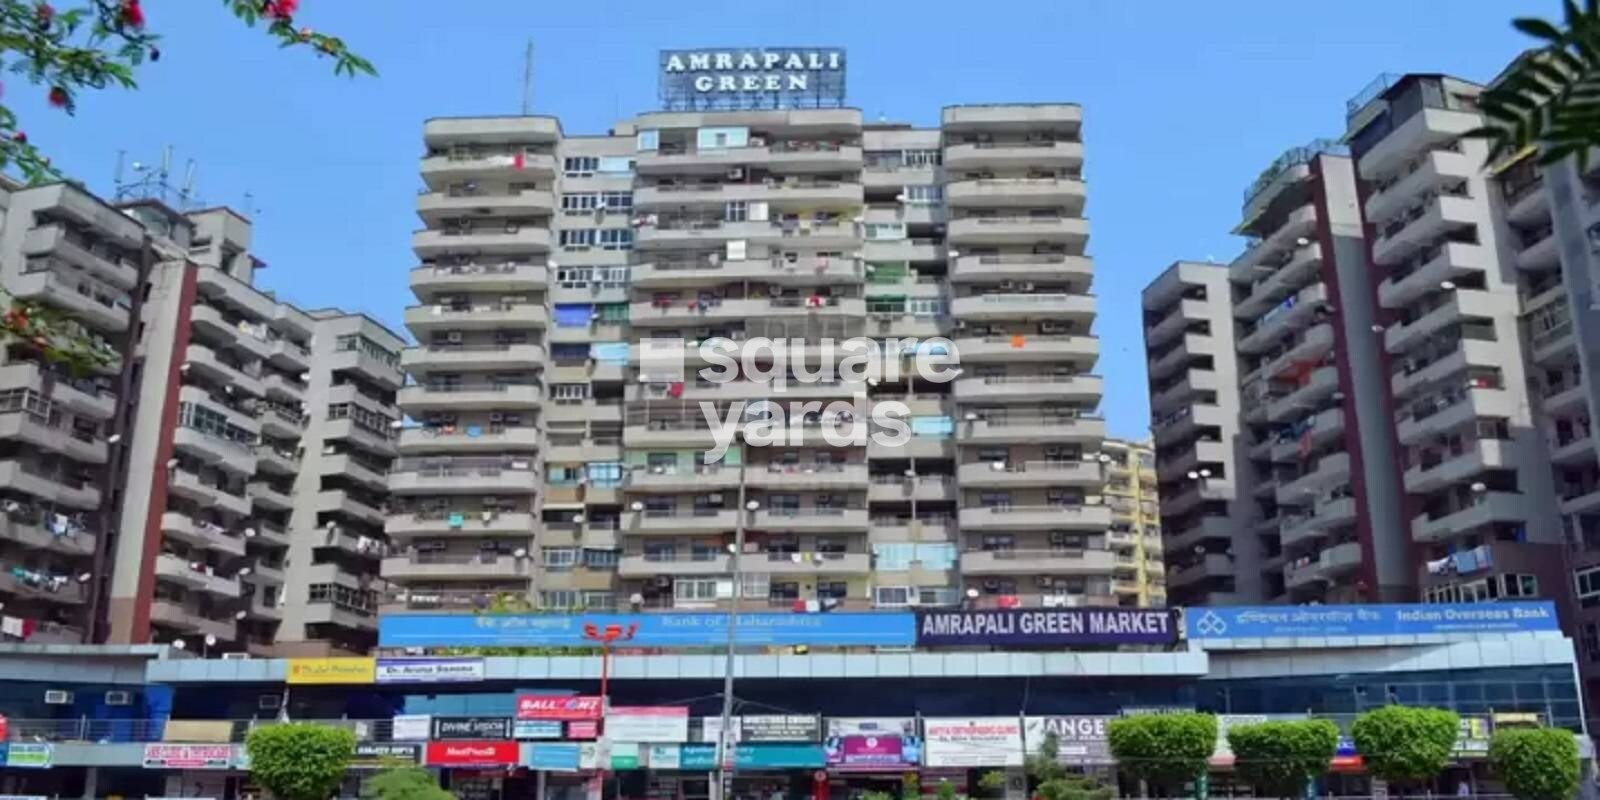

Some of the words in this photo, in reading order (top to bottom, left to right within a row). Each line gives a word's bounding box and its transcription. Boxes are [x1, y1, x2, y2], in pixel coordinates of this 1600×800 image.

[665, 52, 841, 72] AMRAPALI
[695, 74, 809, 93] GREEN
[661, 614, 700, 627] Bank
[704, 614, 722, 627] of
[922, 612, 1016, 635] AMRAPALI
[1019, 612, 1083, 634] GREEN
[1089, 610, 1170, 634] MARKET
[1397, 608, 1443, 622] Indian
[1445, 608, 1510, 622] Overseas
[1513, 606, 1550, 619] Bank
[1046, 717, 1106, 736] ANGE
